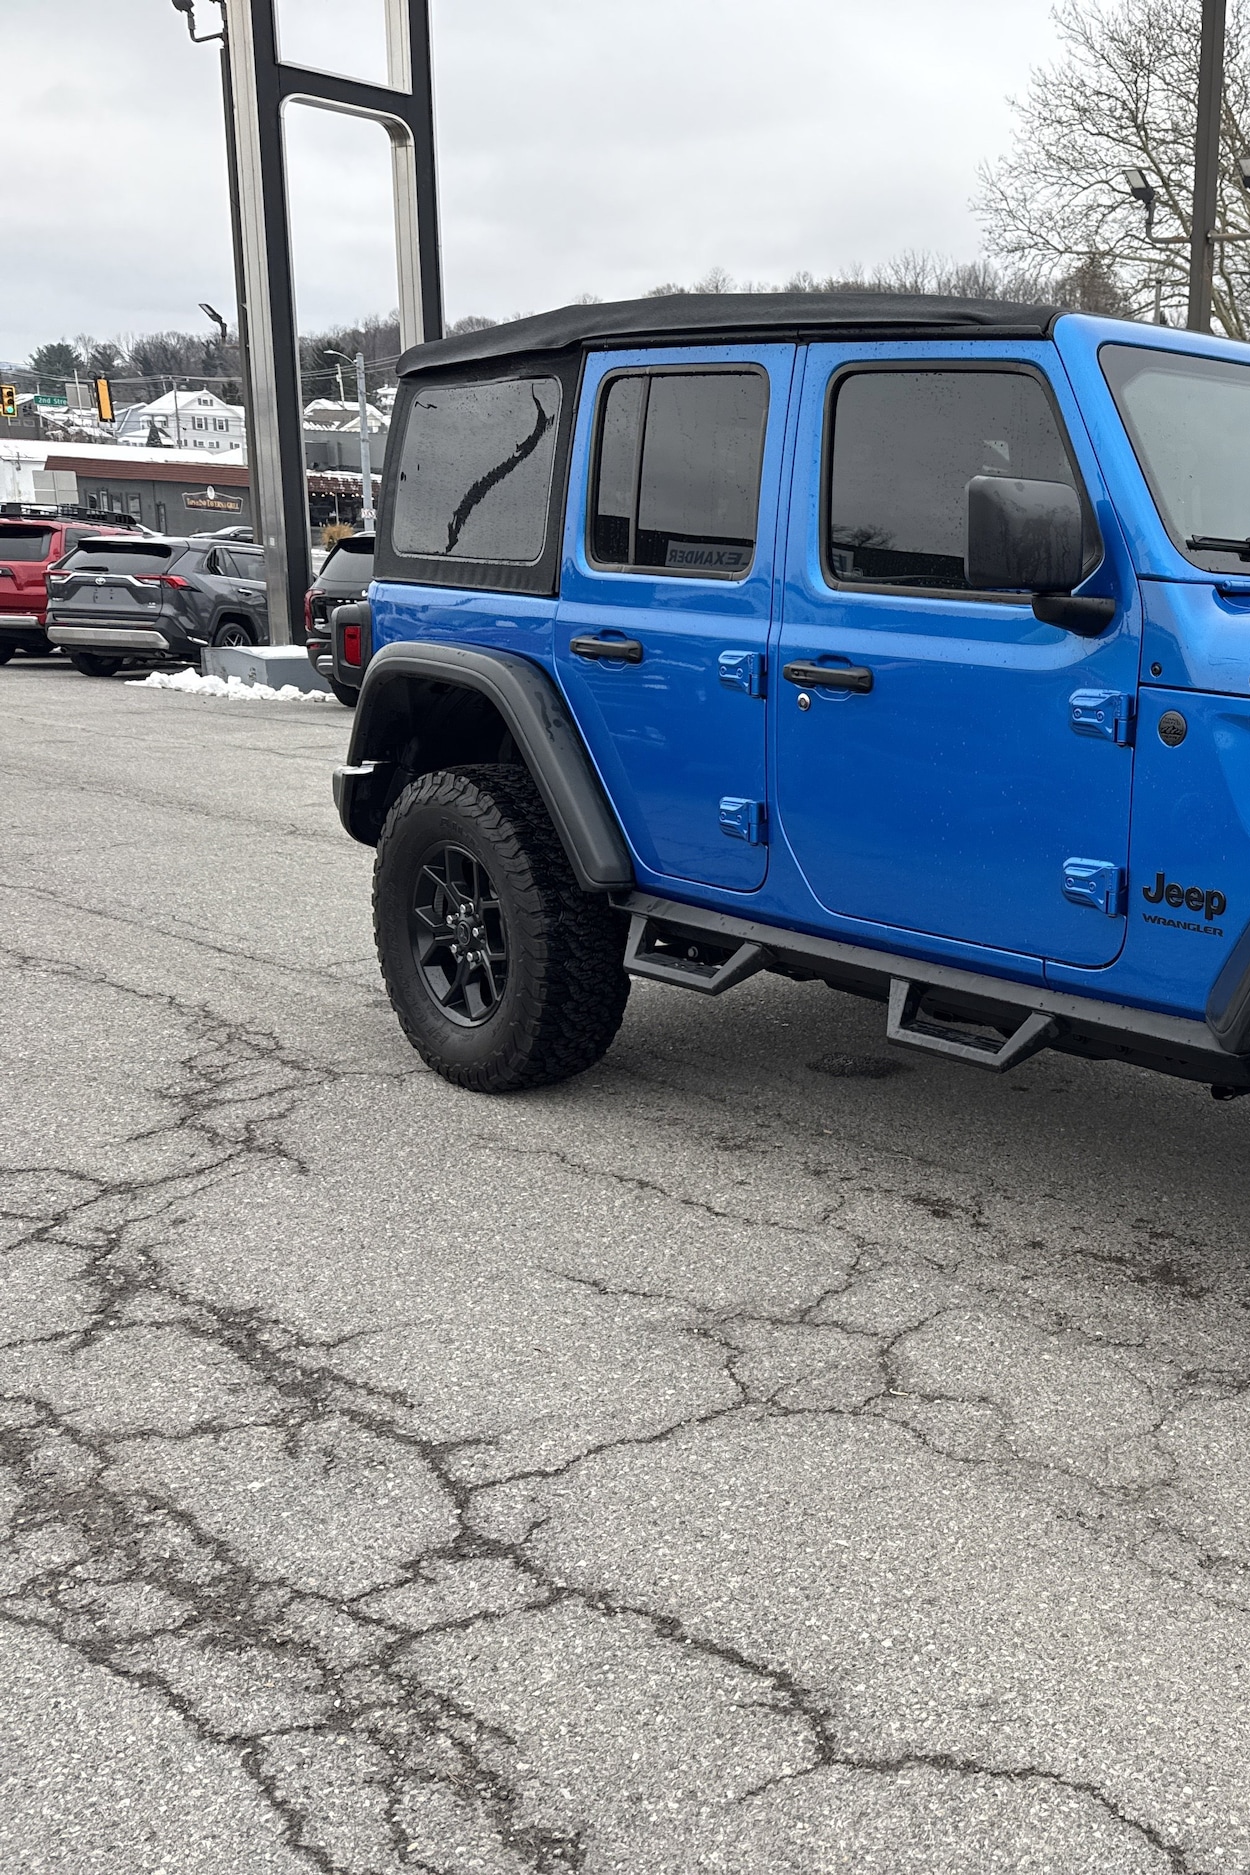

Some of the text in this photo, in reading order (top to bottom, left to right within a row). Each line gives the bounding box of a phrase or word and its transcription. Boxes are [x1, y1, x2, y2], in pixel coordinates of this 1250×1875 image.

[38, 396, 51, 404] 2nd
[1142, 871, 1227, 921] Jeep
[1142, 912, 1224, 937] WRANGLER
